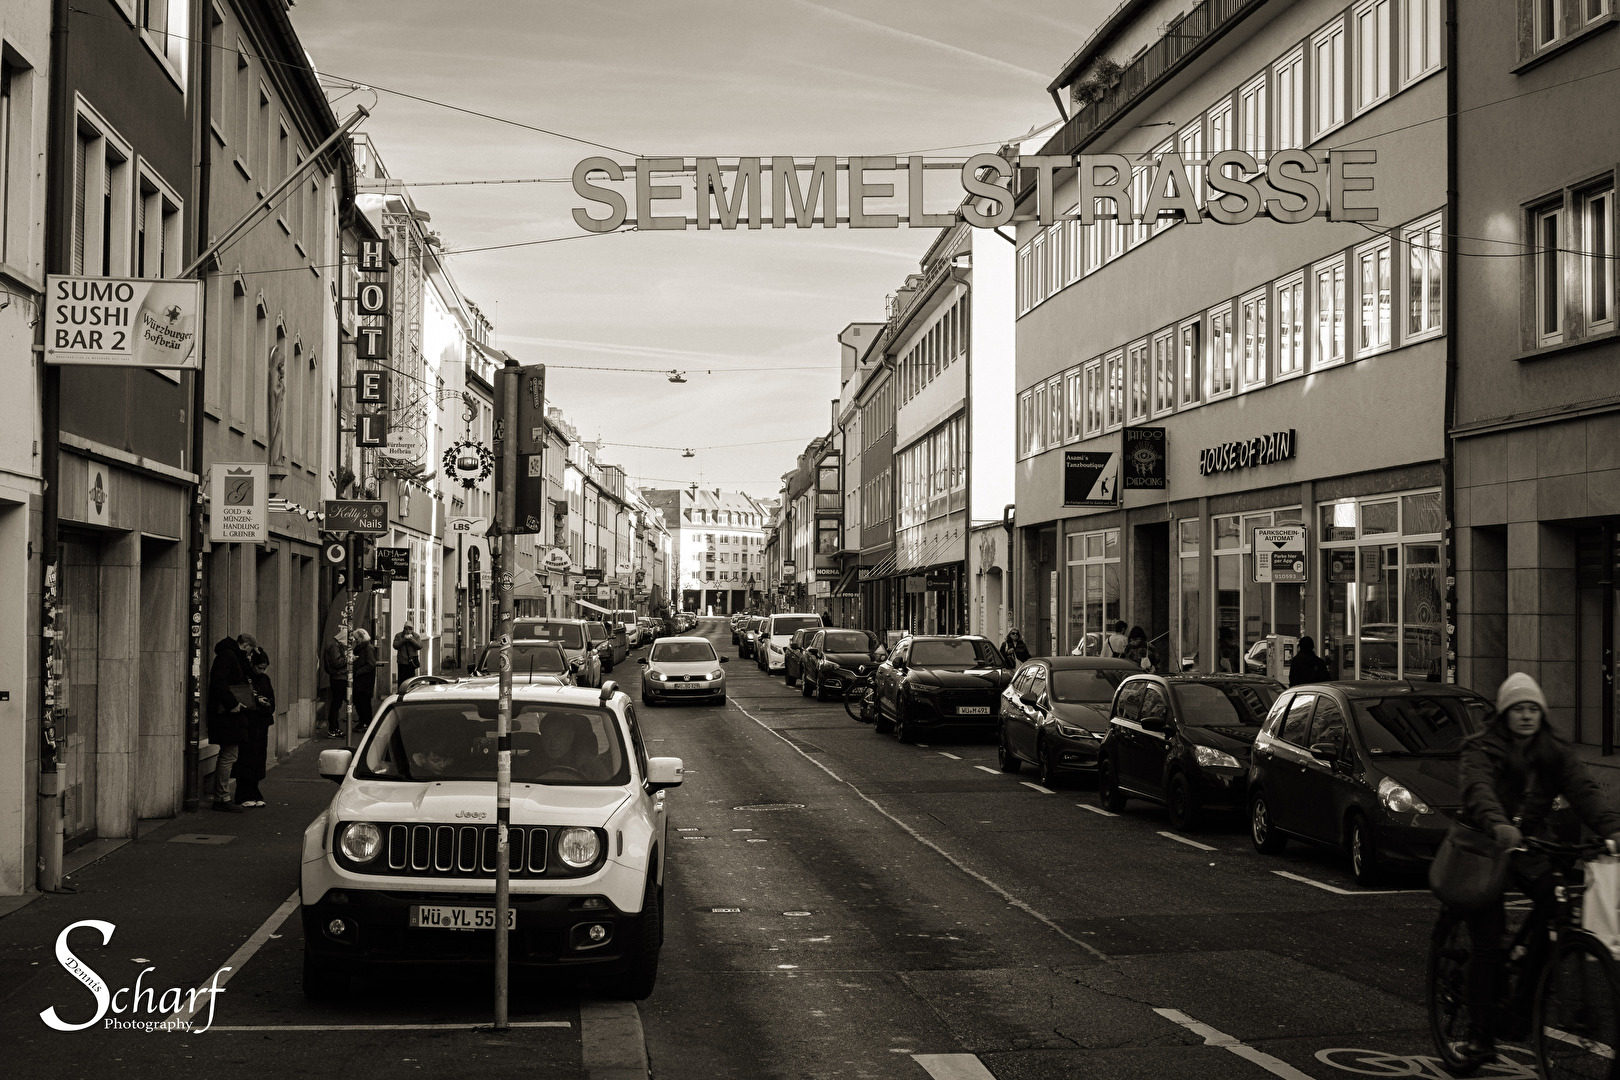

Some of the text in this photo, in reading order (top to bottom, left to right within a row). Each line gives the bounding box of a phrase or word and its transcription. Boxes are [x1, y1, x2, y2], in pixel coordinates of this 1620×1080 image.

[571, 148, 1379, 233] SEMMELSTRASSE
[56, 280, 134, 303] SUMO
[55, 304, 129, 327] SUSHI
[143, 312, 193, 342] Würzburger
[55, 328, 126, 351] BAR 2
[143, 329, 181, 350] Hofbräu
[361, 241, 384, 443] HOTEL
[1126, 429, 1163, 441] TATTOO
[1066, 462, 1105, 470] Tanzboutique
[1199, 441, 1241, 476] HOUSE
[1240, 437, 1261, 468] OF
[222, 522, 260, 530] HANDLUNG
[359, 518, 383, 529] Nails
[453, 523, 470, 531] LBS
[455, 810, 488, 820] Jeep
[421, 908, 441, 924] WÜ
[452, 909, 471, 926] YL
[474, 910, 513, 927] 553
